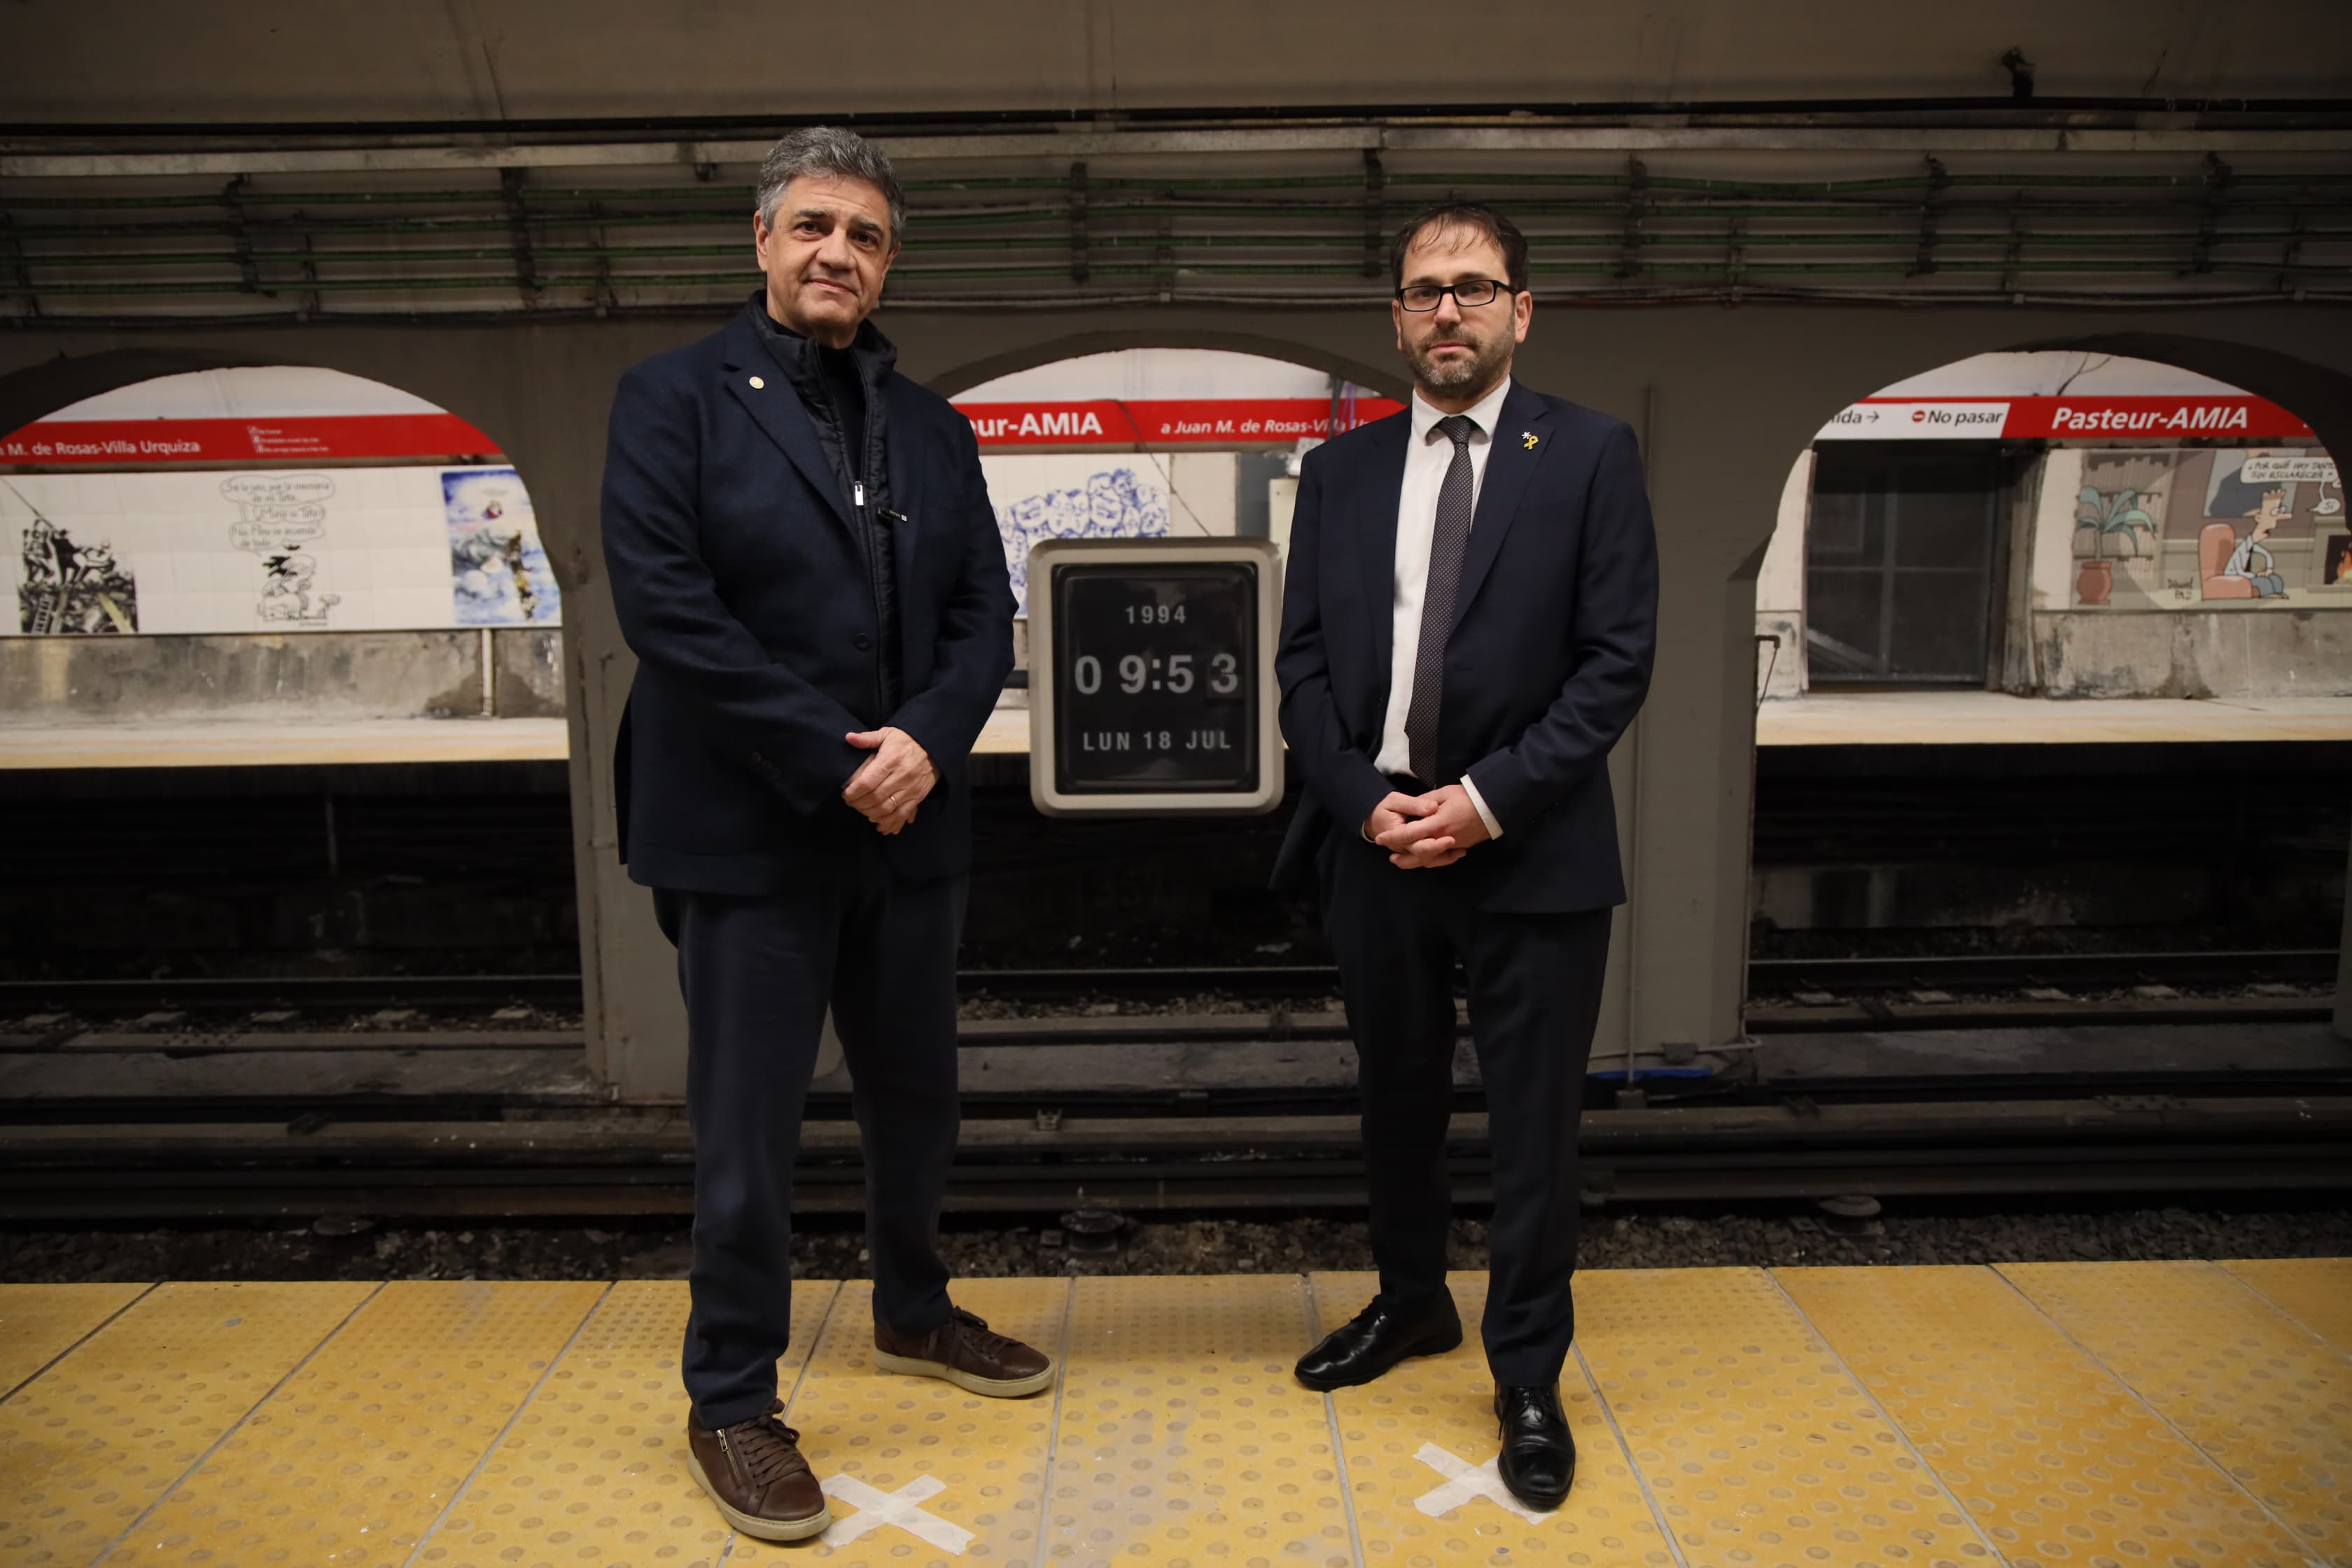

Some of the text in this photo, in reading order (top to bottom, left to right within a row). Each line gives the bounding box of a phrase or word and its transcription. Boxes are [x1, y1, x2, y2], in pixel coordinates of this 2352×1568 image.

[1161, 423, 1170, 434] a
[1174, 421, 1211, 434] Juan
[1215, 420, 1235, 433] M.
[1240, 419, 1260, 433] de
[1928, 410, 2003, 426] No pasar
[2052, 407, 2248, 430] Pasteur-AMIA
[7, 442, 29, 456] M.
[32, 442, 52, 455] de
[55, 440, 137, 455] Rosas-Villa
[140, 440, 202, 456] Urquiza
[1125, 605, 1186, 624] 1994
[1082, 730, 1231, 751] LUN 18 JUL
